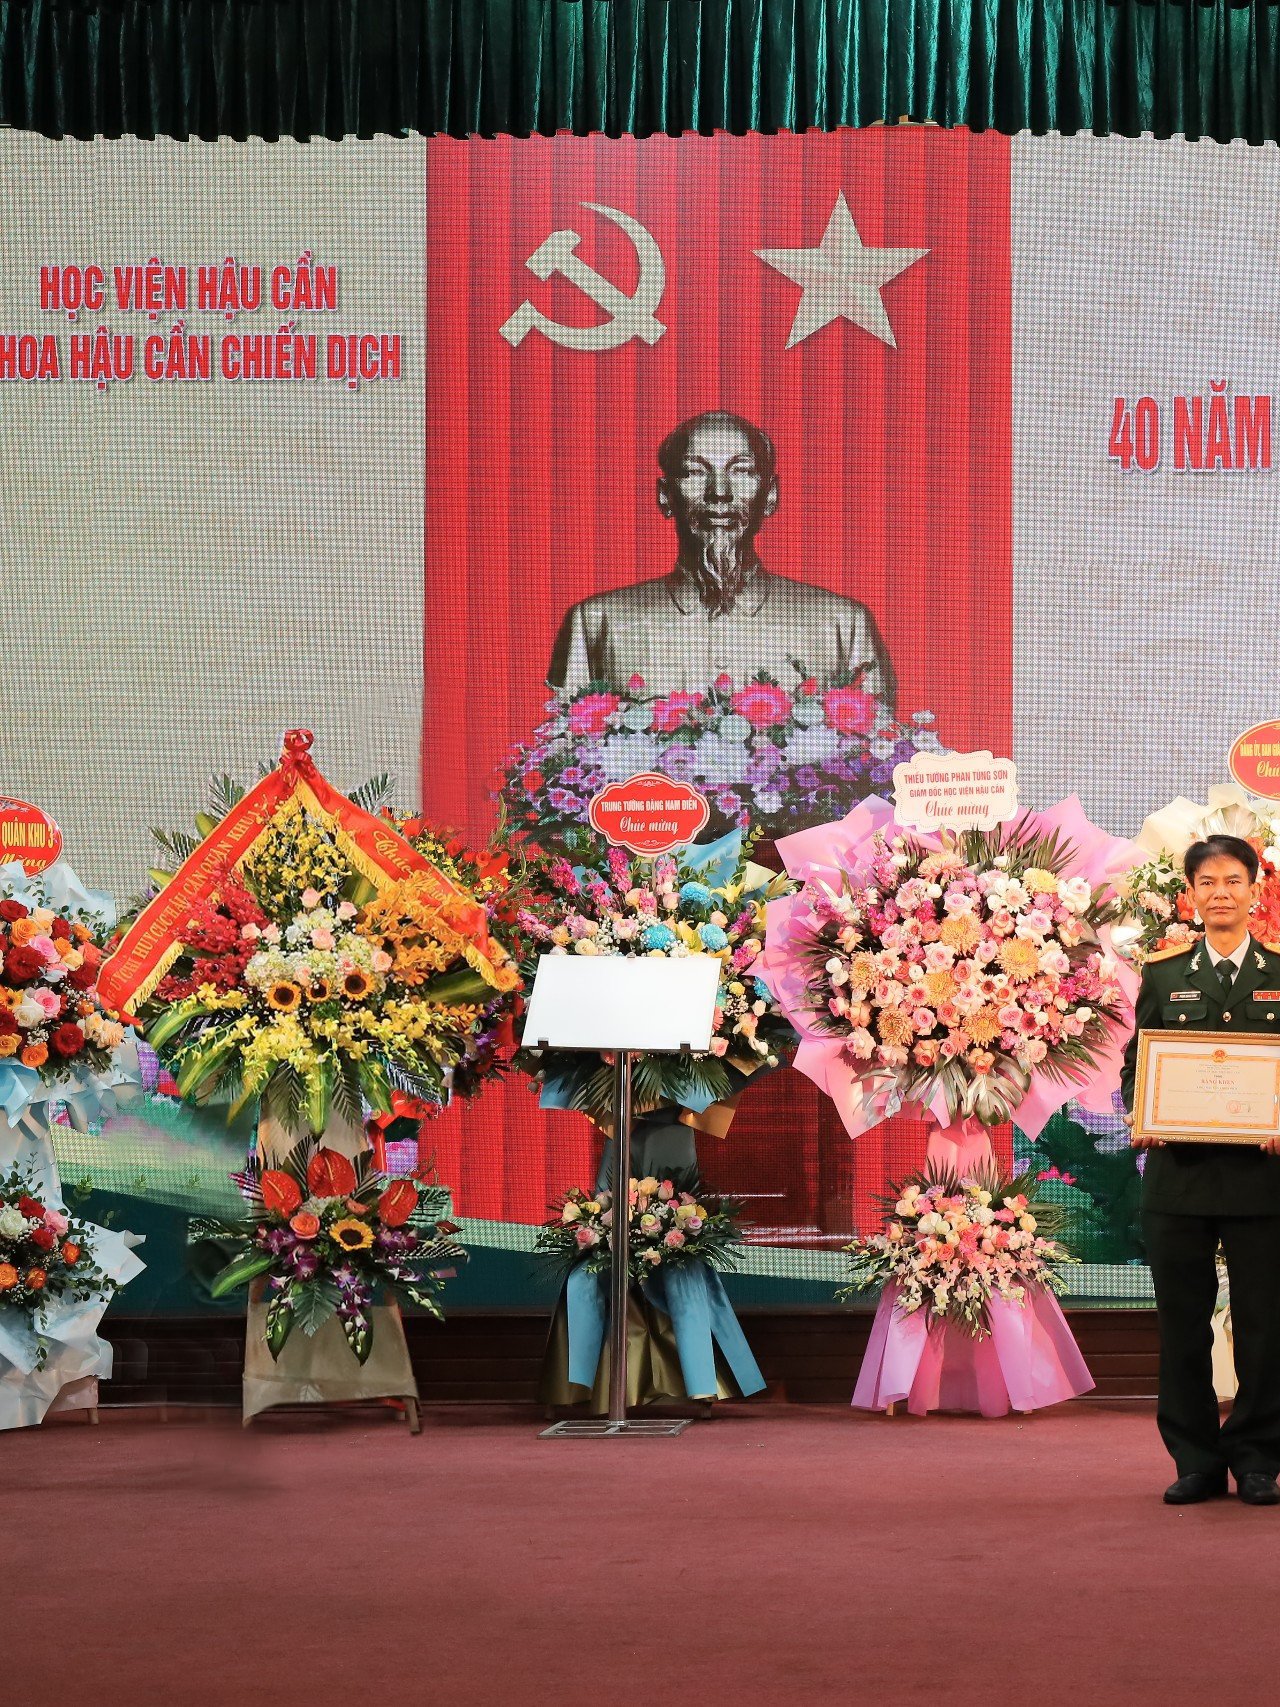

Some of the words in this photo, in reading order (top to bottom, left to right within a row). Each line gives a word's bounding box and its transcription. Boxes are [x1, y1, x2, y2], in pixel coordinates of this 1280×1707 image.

[40, 264, 104, 321] HỌC
[113, 257, 188, 321] VIỆN
[197, 256, 261, 321] HẬU
[70, 325, 134, 391] HẬU
[221, 320, 317, 380] CHIẾN
[327, 333, 401, 390] DỊCH
[1108, 396, 1160, 470] 40
[1173, 380, 1272, 470] NĂM
[951, 771, 970, 782] PHAN
[620, 816, 645, 832] Chúc
[648, 819, 678, 835] mừng
[925, 800, 953, 817] Chúc
[957, 801, 989, 818] mừng
[1, 816, 26, 849] QUÂN
[27, 822, 46, 848] KHU
[47, 824, 54, 849] 3
[227, 816, 255, 843] KHU
[373, 830, 413, 877] Chúc
